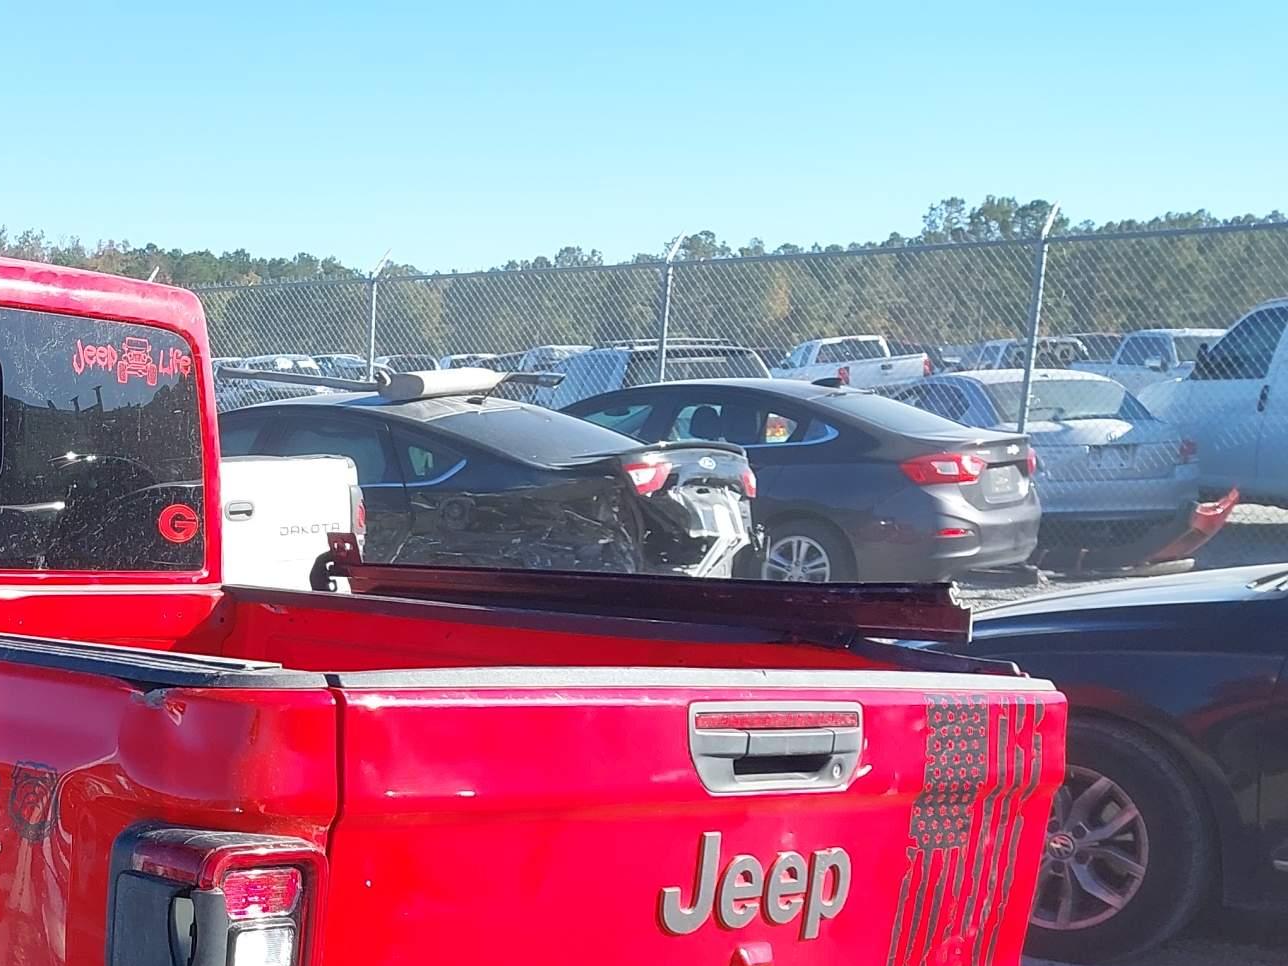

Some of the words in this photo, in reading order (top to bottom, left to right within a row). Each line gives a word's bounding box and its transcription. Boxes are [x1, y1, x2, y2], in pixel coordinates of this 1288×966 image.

[158, 504, 199, 543] G
[279, 523, 340, 536] DAKOTA
[658, 831, 851, 940] Jeep
